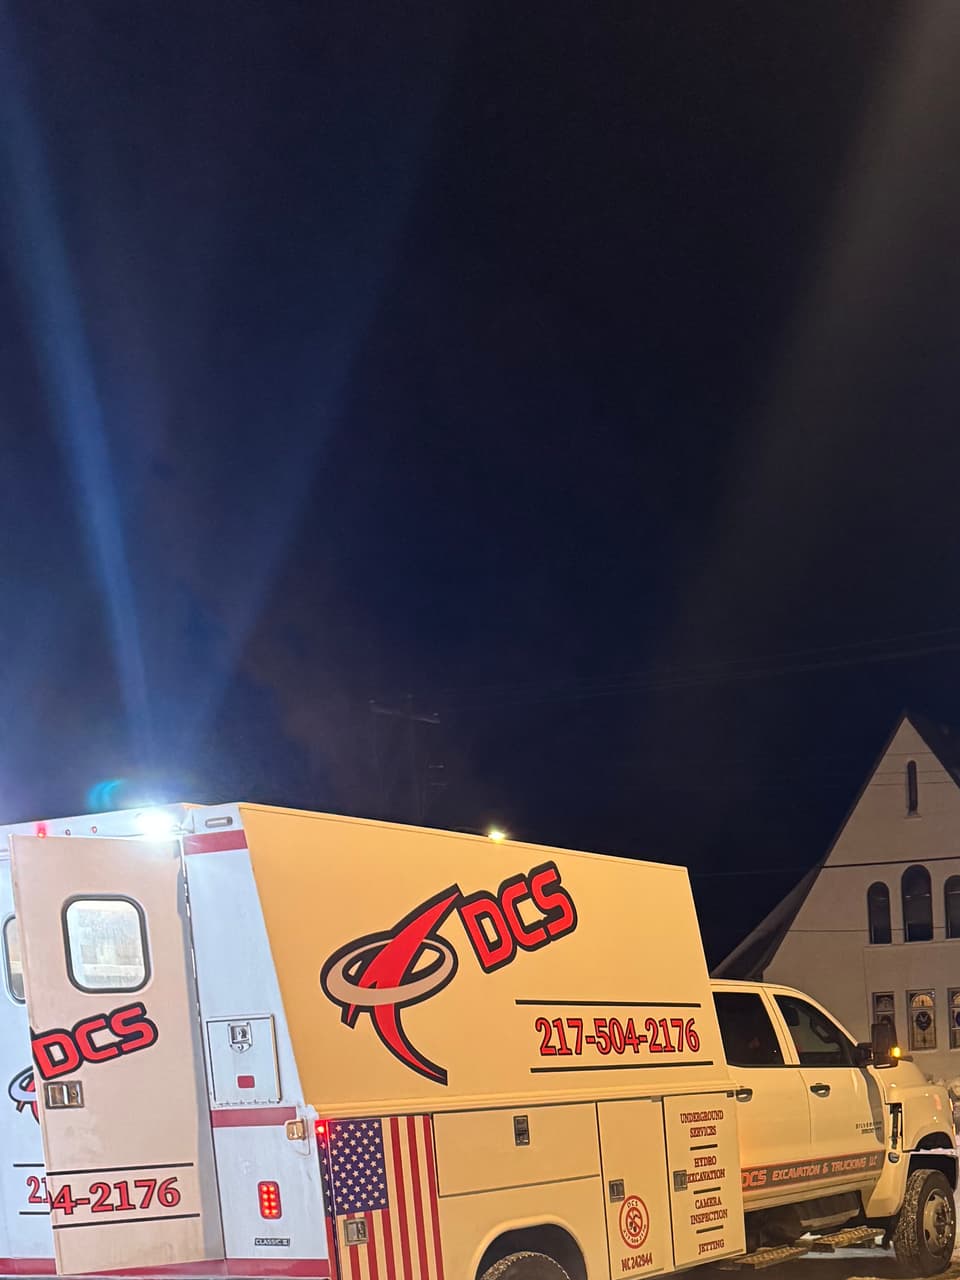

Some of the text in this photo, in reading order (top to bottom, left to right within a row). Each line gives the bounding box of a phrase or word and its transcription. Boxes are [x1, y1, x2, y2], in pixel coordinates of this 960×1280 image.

[461, 861, 578, 974] DCS
[31, 1002, 158, 1081] DCS
[535, 1017, 701, 1056] 217-504-2176
[680, 1110, 724, 1124] UNDERGROUND
[690, 1125, 717, 1138] SERVICES
[694, 1155, 717, 1168] HYDRO
[687, 1168, 726, 1184] EXCAVATION
[741, 1169, 767, 1187] DCS
[772, 1165, 820, 1181] EXCAVATION
[822, 1162, 829, 1174] &
[831, 1157, 867, 1172] TRUCKING
[694, 1196, 722, 1210] CAMERA
[690, 1209, 728, 1225] INSPECTION
[698, 1239, 725, 1255] JETTING
